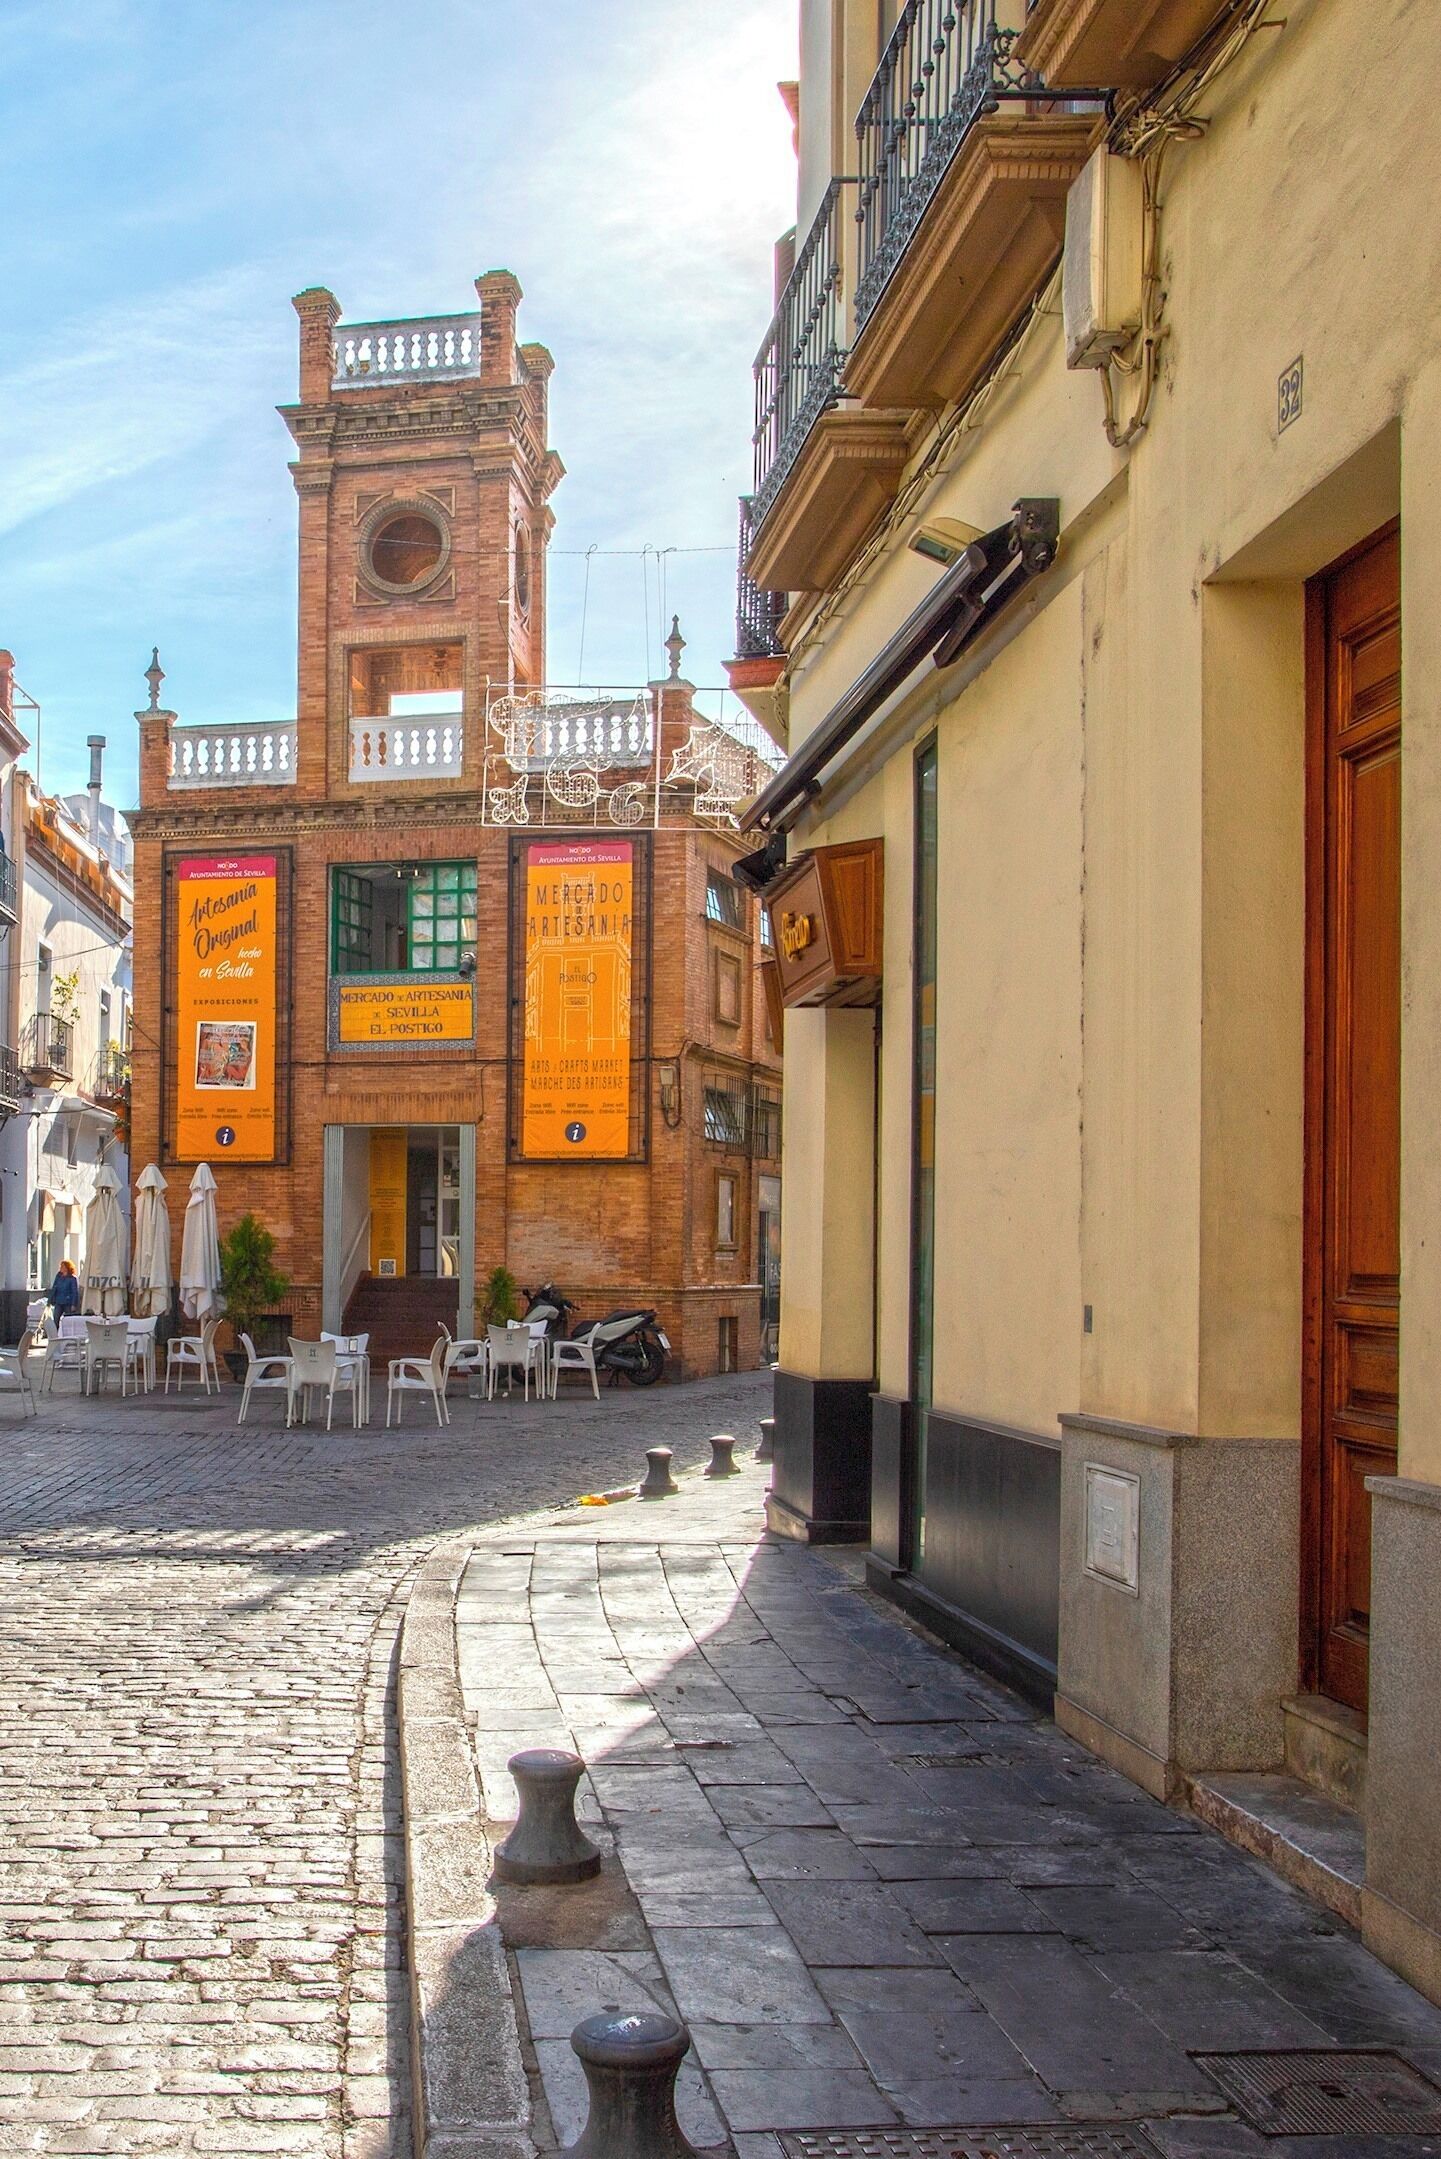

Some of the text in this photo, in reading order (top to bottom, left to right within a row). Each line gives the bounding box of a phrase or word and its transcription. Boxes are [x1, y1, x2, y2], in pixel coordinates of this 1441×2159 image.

[1281, 369, 1300, 423] 32
[244, 869, 266, 877] SEVILLA
[536, 882, 623, 906] MERCADO
[187, 882, 258, 930] Artesanía
[193, 910, 257, 960] Original
[237, 946, 262, 959] hecho
[199, 960, 254, 980] en Sevilla
[193, 998, 259, 1006] EXPOSICIONES
[340, 991, 395, 1003] MERCADO
[386, 1006, 440, 1018] SEVILLA
[370, 1022, 443, 1035] EL POSTIGO
[531, 1060, 550, 1073] ARTS
[559, 1059, 589, 1073] CRAFTS
[592, 1059, 623, 1072] MARKET
[566, 1076, 581, 1090] DES
[584, 1076, 623, 1089] ARTISANS
